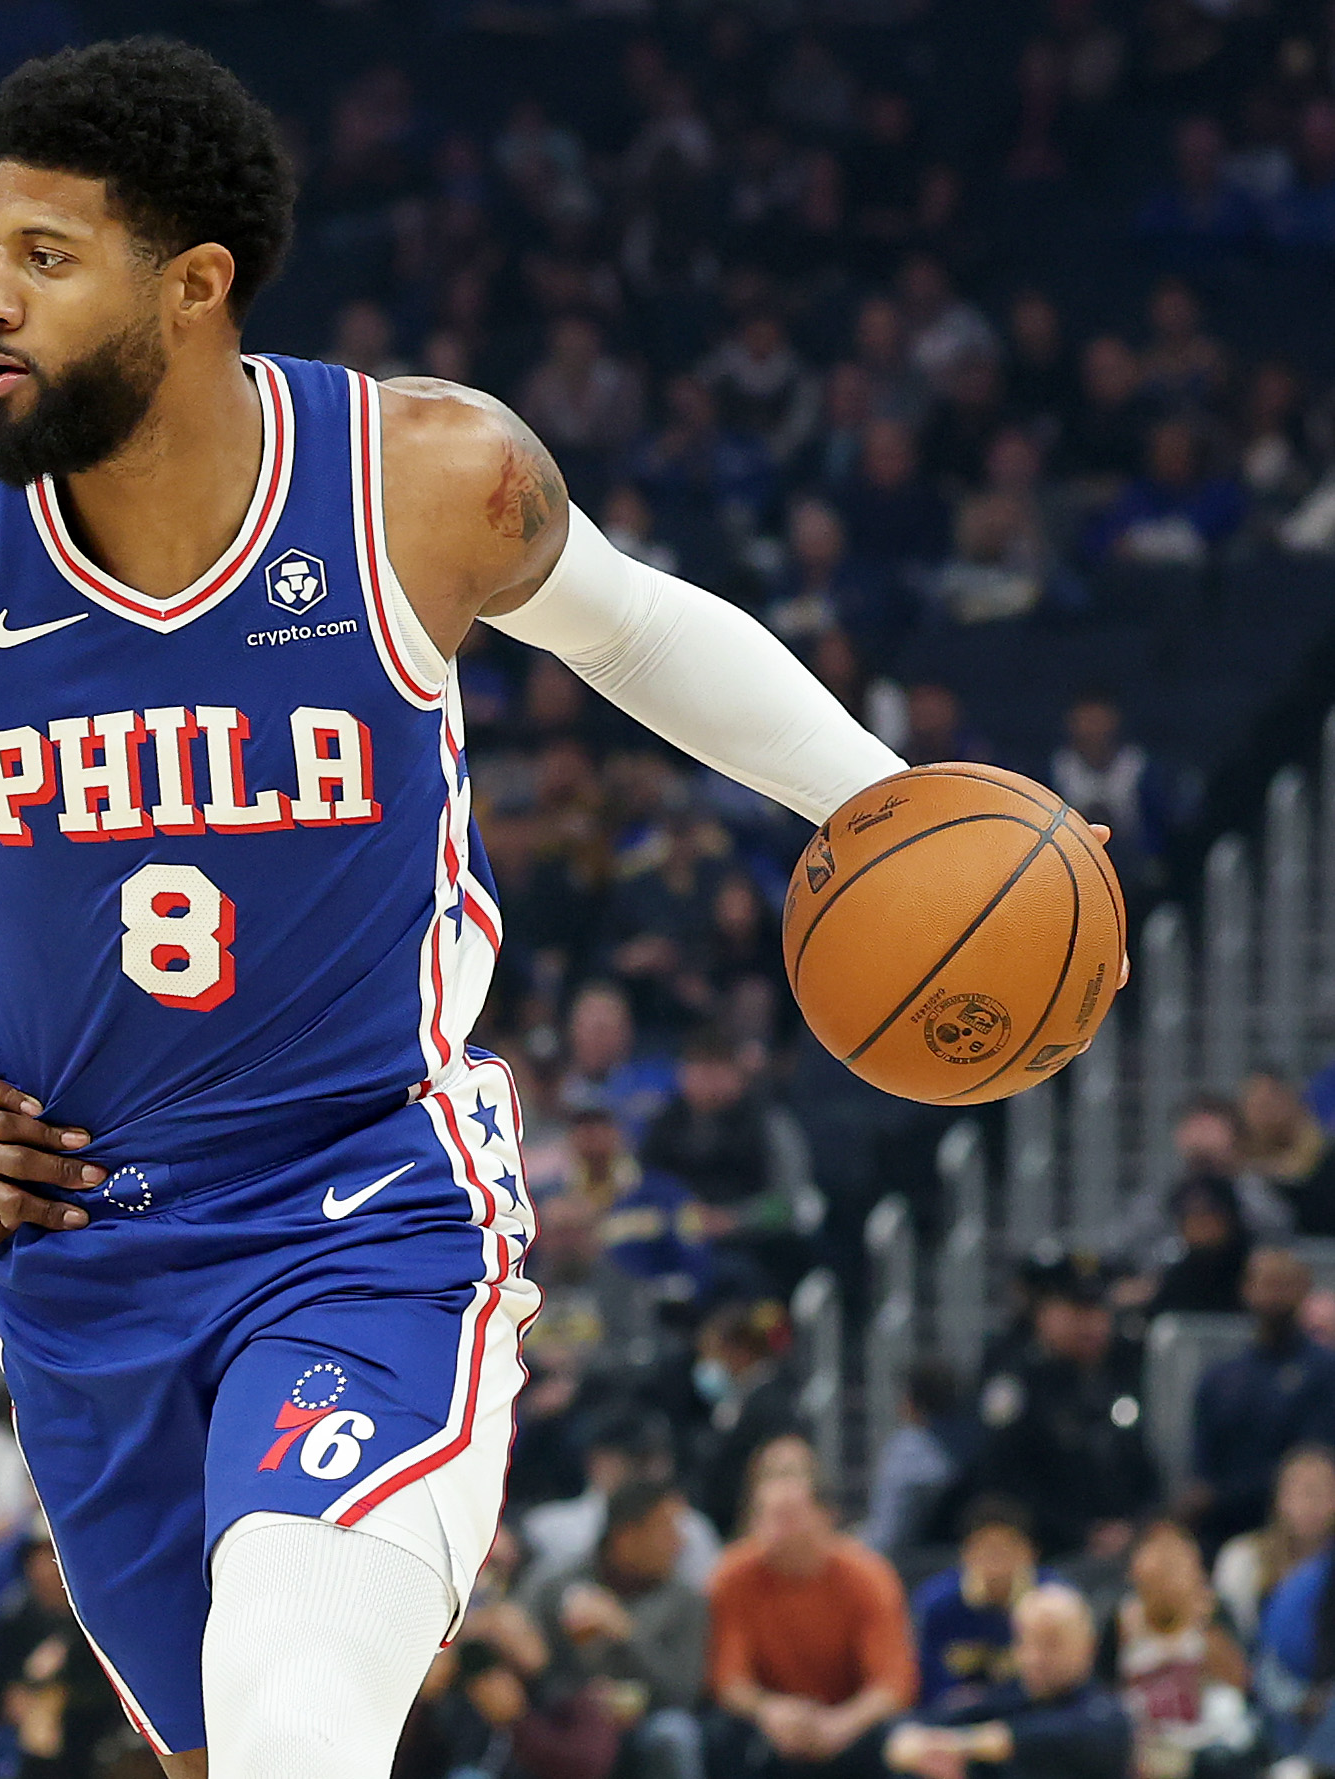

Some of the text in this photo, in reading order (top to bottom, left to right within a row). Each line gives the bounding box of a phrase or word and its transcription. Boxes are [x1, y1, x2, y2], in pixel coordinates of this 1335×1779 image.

[247, 620, 357, 646] crypto.com
[121, 863, 236, 1012] 8
[258, 1400, 375, 1480] 76
